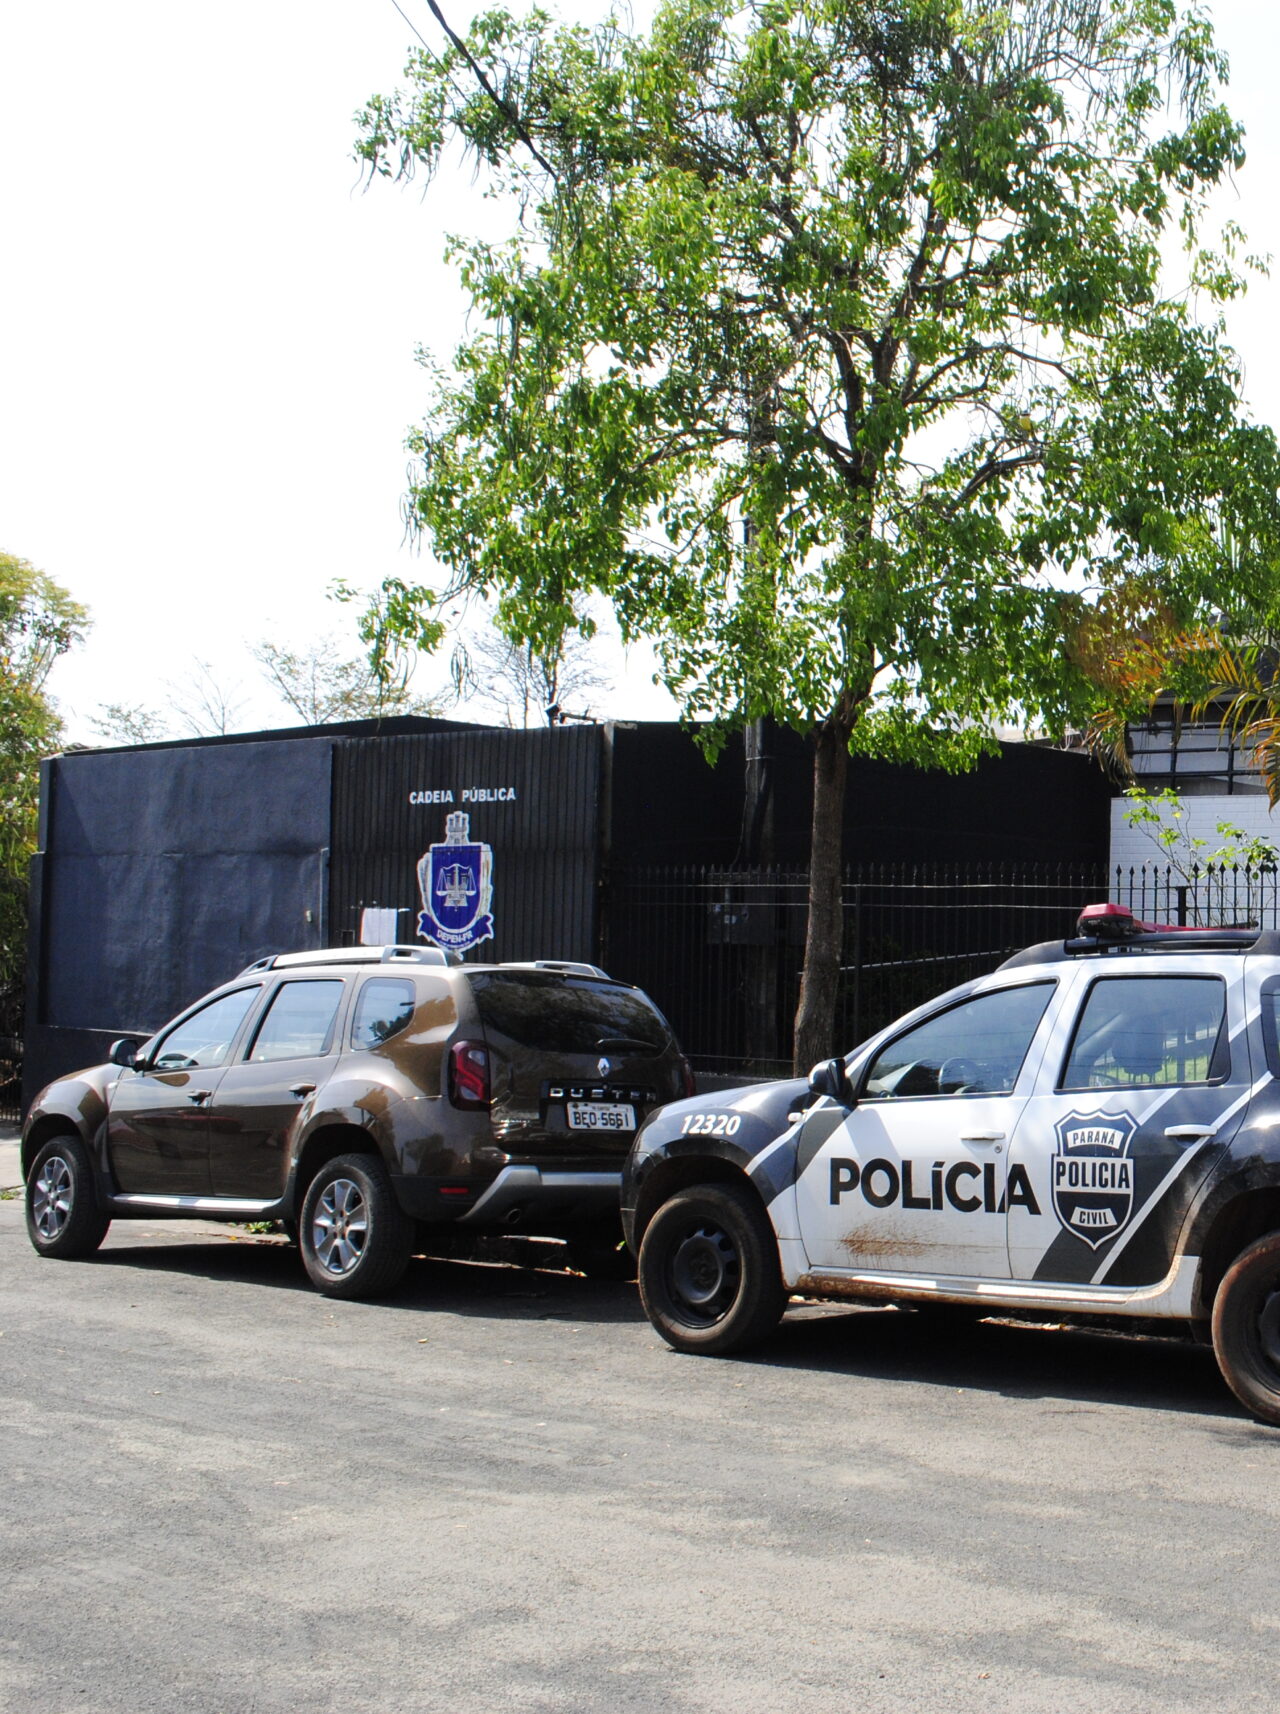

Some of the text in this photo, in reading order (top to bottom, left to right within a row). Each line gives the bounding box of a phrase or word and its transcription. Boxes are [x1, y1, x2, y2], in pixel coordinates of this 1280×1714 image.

[409, 786, 516, 805] CADEIA PÚBLICA
[681, 1113, 742, 1136] 12320
[1072, 1130, 1117, 1145] PARANÁ
[1056, 1161, 1130, 1189] POLICIA
[829, 1157, 1042, 1216] POLÍCIA
[1079, 1210, 1109, 1225] CIVIL
